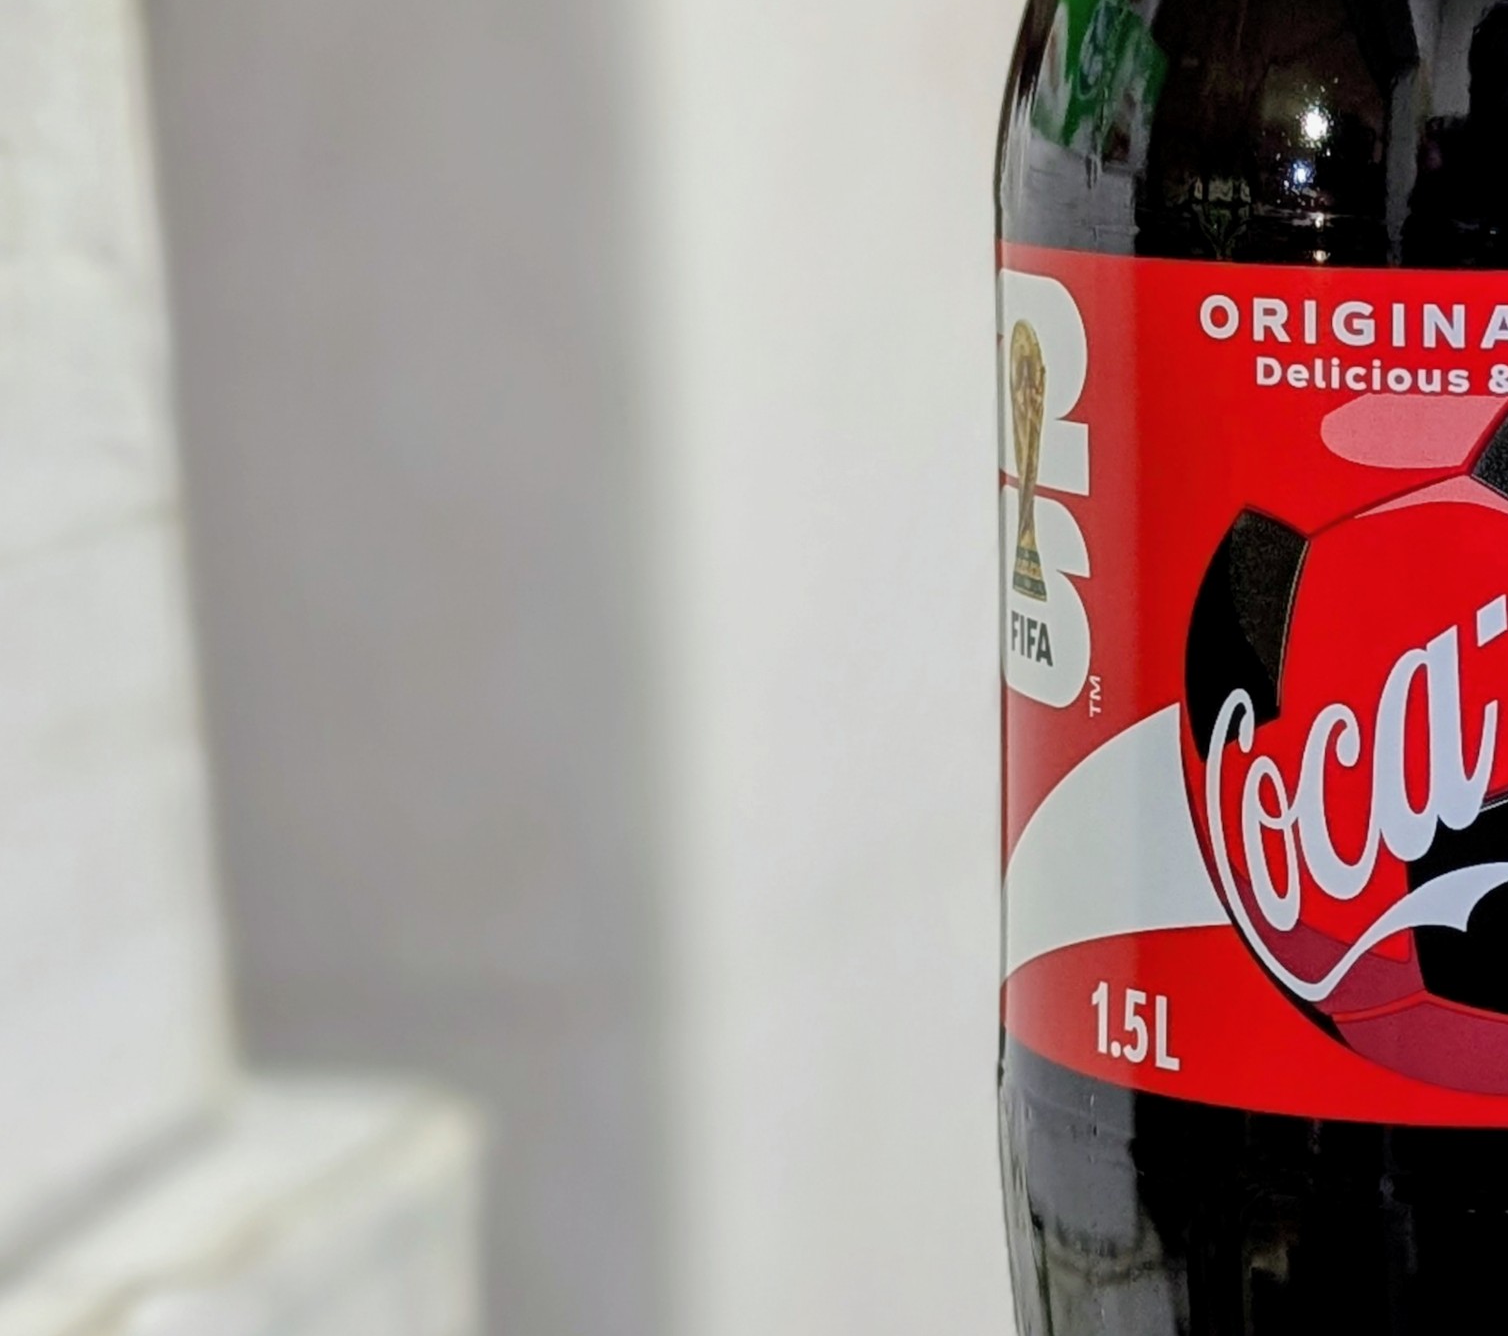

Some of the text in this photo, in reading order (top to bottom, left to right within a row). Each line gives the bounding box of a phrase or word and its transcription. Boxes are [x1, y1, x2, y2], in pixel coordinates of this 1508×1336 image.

[1255, 356, 1471, 394] Delicious
[1011, 610, 1054, 668] FIFA
[1091, 980, 1181, 1072] 1.5L
